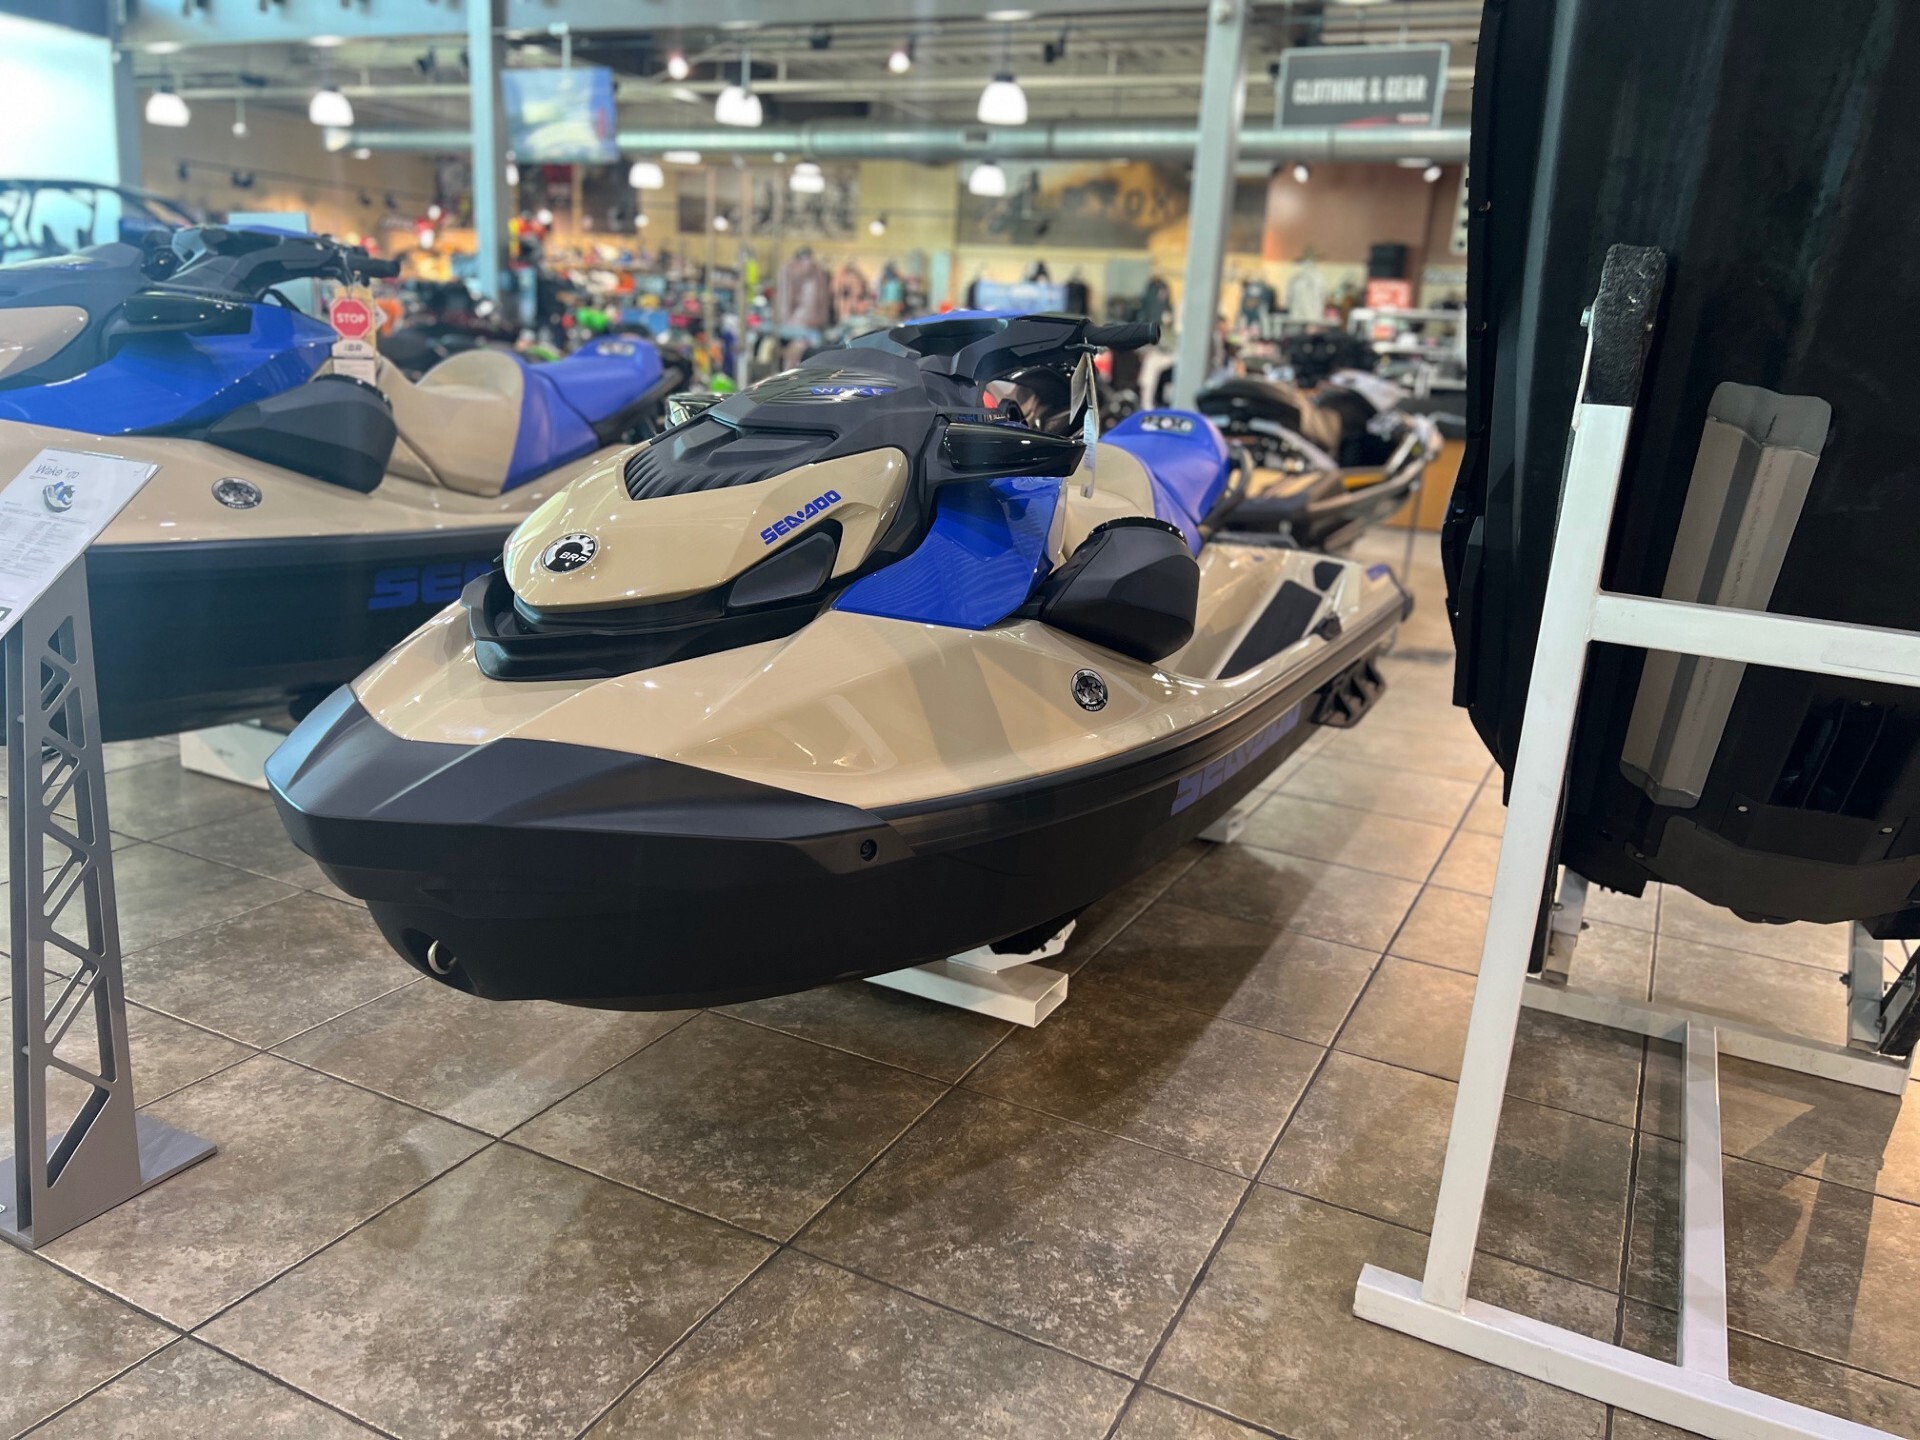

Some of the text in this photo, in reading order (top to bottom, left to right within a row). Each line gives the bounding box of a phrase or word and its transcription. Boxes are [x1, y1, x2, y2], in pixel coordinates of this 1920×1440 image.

[1292, 74, 1427, 105] CLOTHING & GEAR
[336, 313, 366, 324] STOP
[36, 465, 63, 477] Wake
[559, 551, 588, 562] BRP
